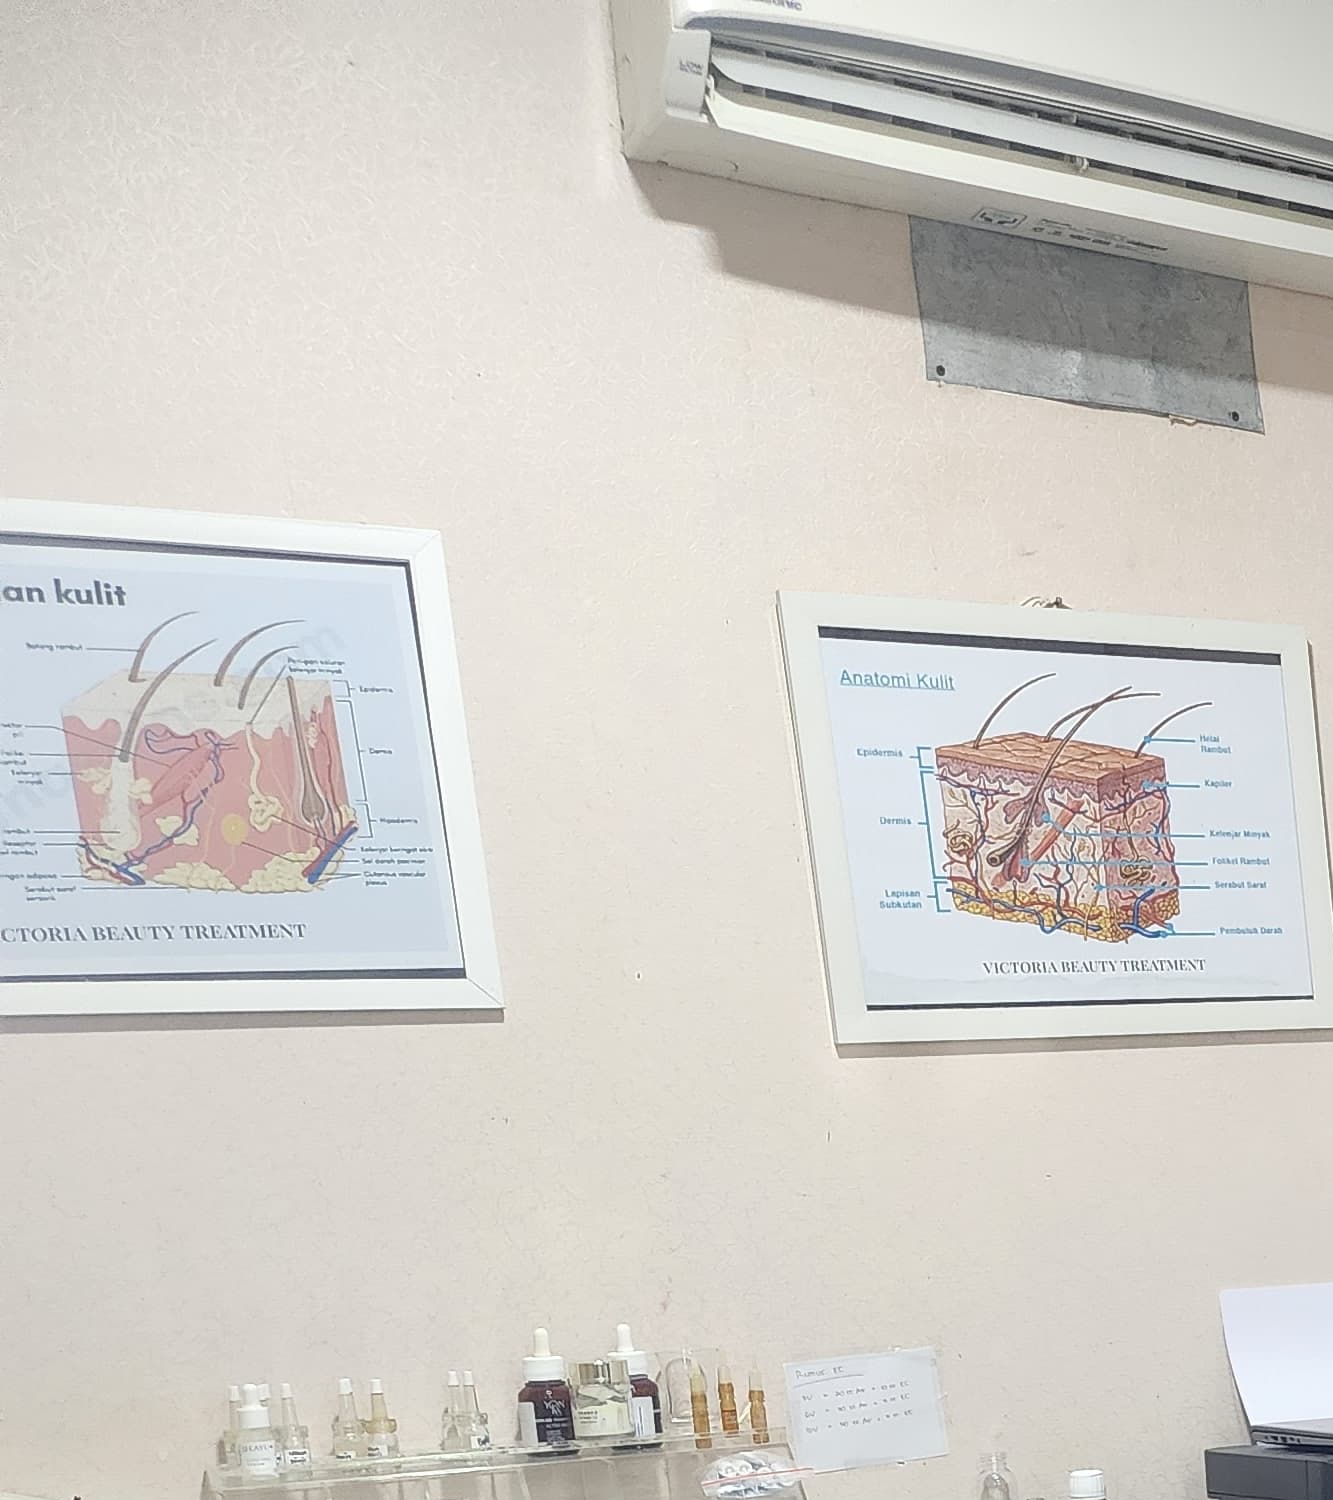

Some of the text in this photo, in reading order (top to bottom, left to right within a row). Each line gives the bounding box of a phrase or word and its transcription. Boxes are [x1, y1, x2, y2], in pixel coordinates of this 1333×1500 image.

[53, 577, 126, 606] kulit
[840, 669, 955, 690] Anatomi Kulit
[856, 747, 904, 758] Epidermis
[879, 816, 913, 826] Dermis
[884, 889, 921, 899] Lapisan
[879, 900, 923, 909] Subkutan
[92, 925, 174, 942] BEAUTY
[180, 923, 307, 940] TREATMENT
[982, 958, 1207, 975] VICTORIA BEAUTY TREATMENT
